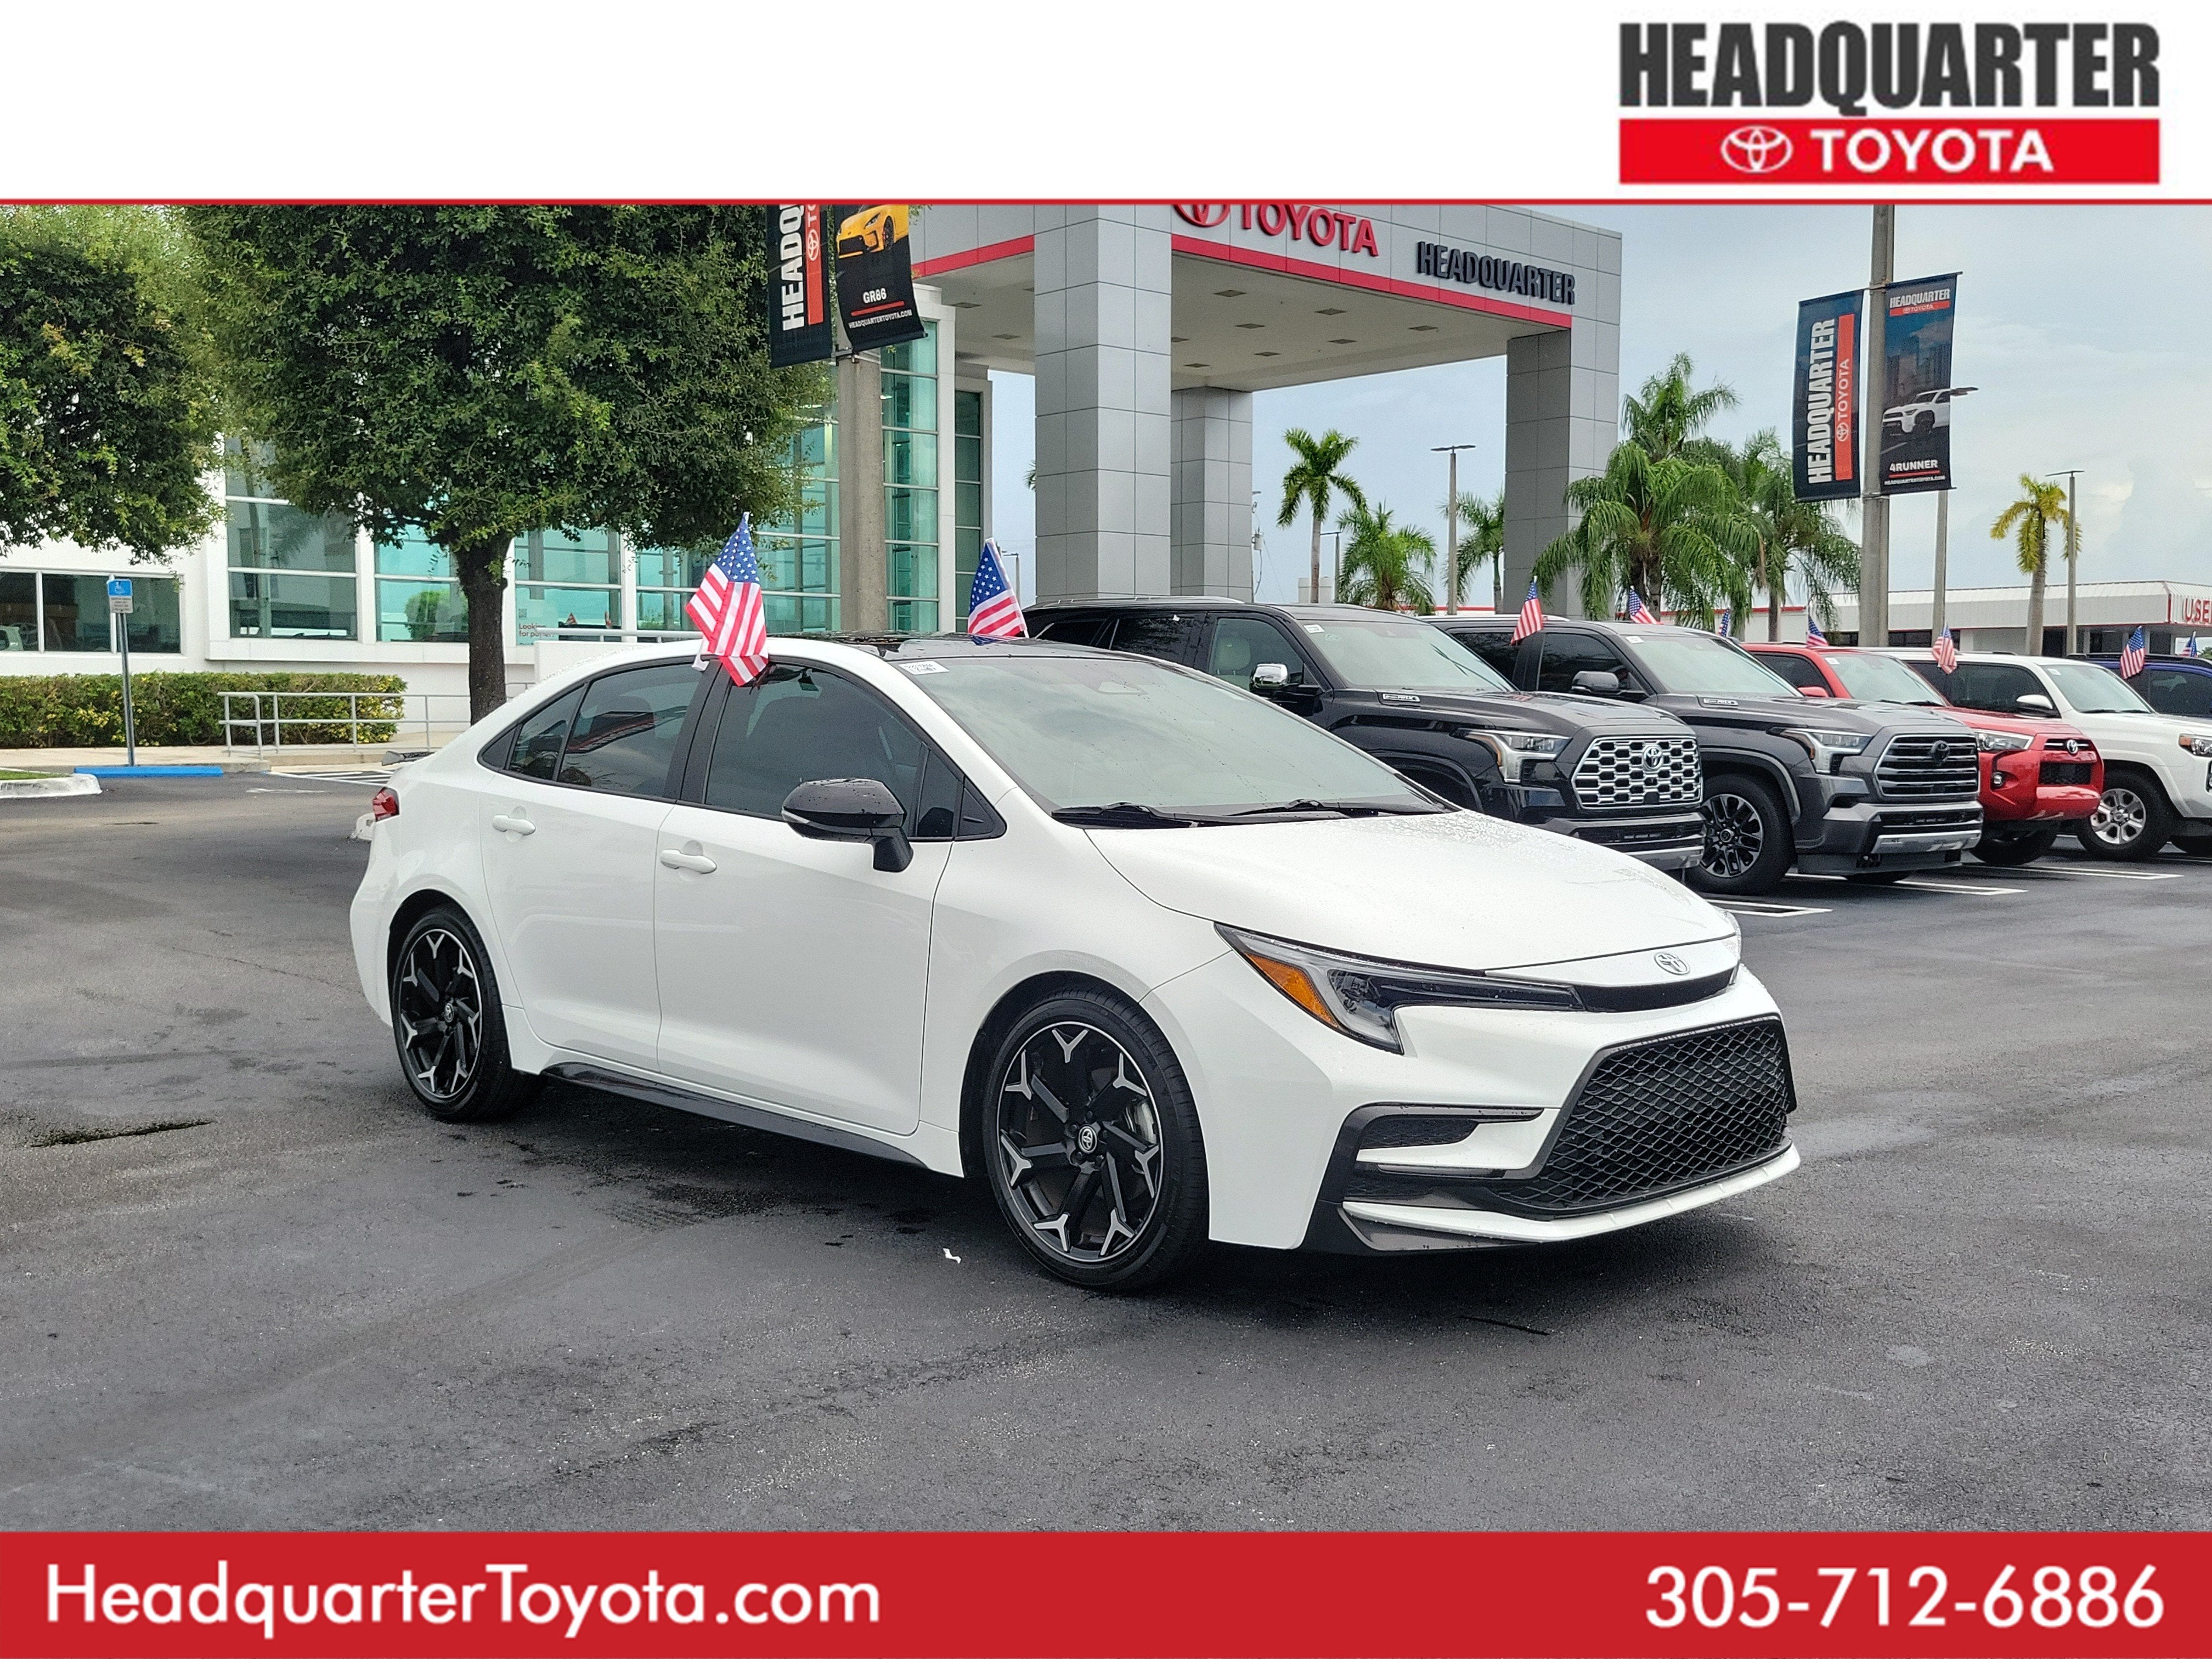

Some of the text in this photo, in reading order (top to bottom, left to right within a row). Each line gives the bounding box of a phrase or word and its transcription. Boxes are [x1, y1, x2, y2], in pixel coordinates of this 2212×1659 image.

[1240, 205, 1379, 257] TOYOTA
[780, 205, 805, 331] HEADQ
[1418, 241, 1575, 305] HEADQUARTER
[862, 288, 887, 303] GR86
[1889, 289, 1950, 308] HEADQUARTER
[848, 309, 913, 329] HEADQUARTERTOYOTA.COM
[1807, 319, 1835, 484] HEADQUARTER
[1838, 359, 1849, 420] TOYOTA
[1889, 459, 1939, 472] 4RUNNER
[2185, 598, 2212, 623] USE
